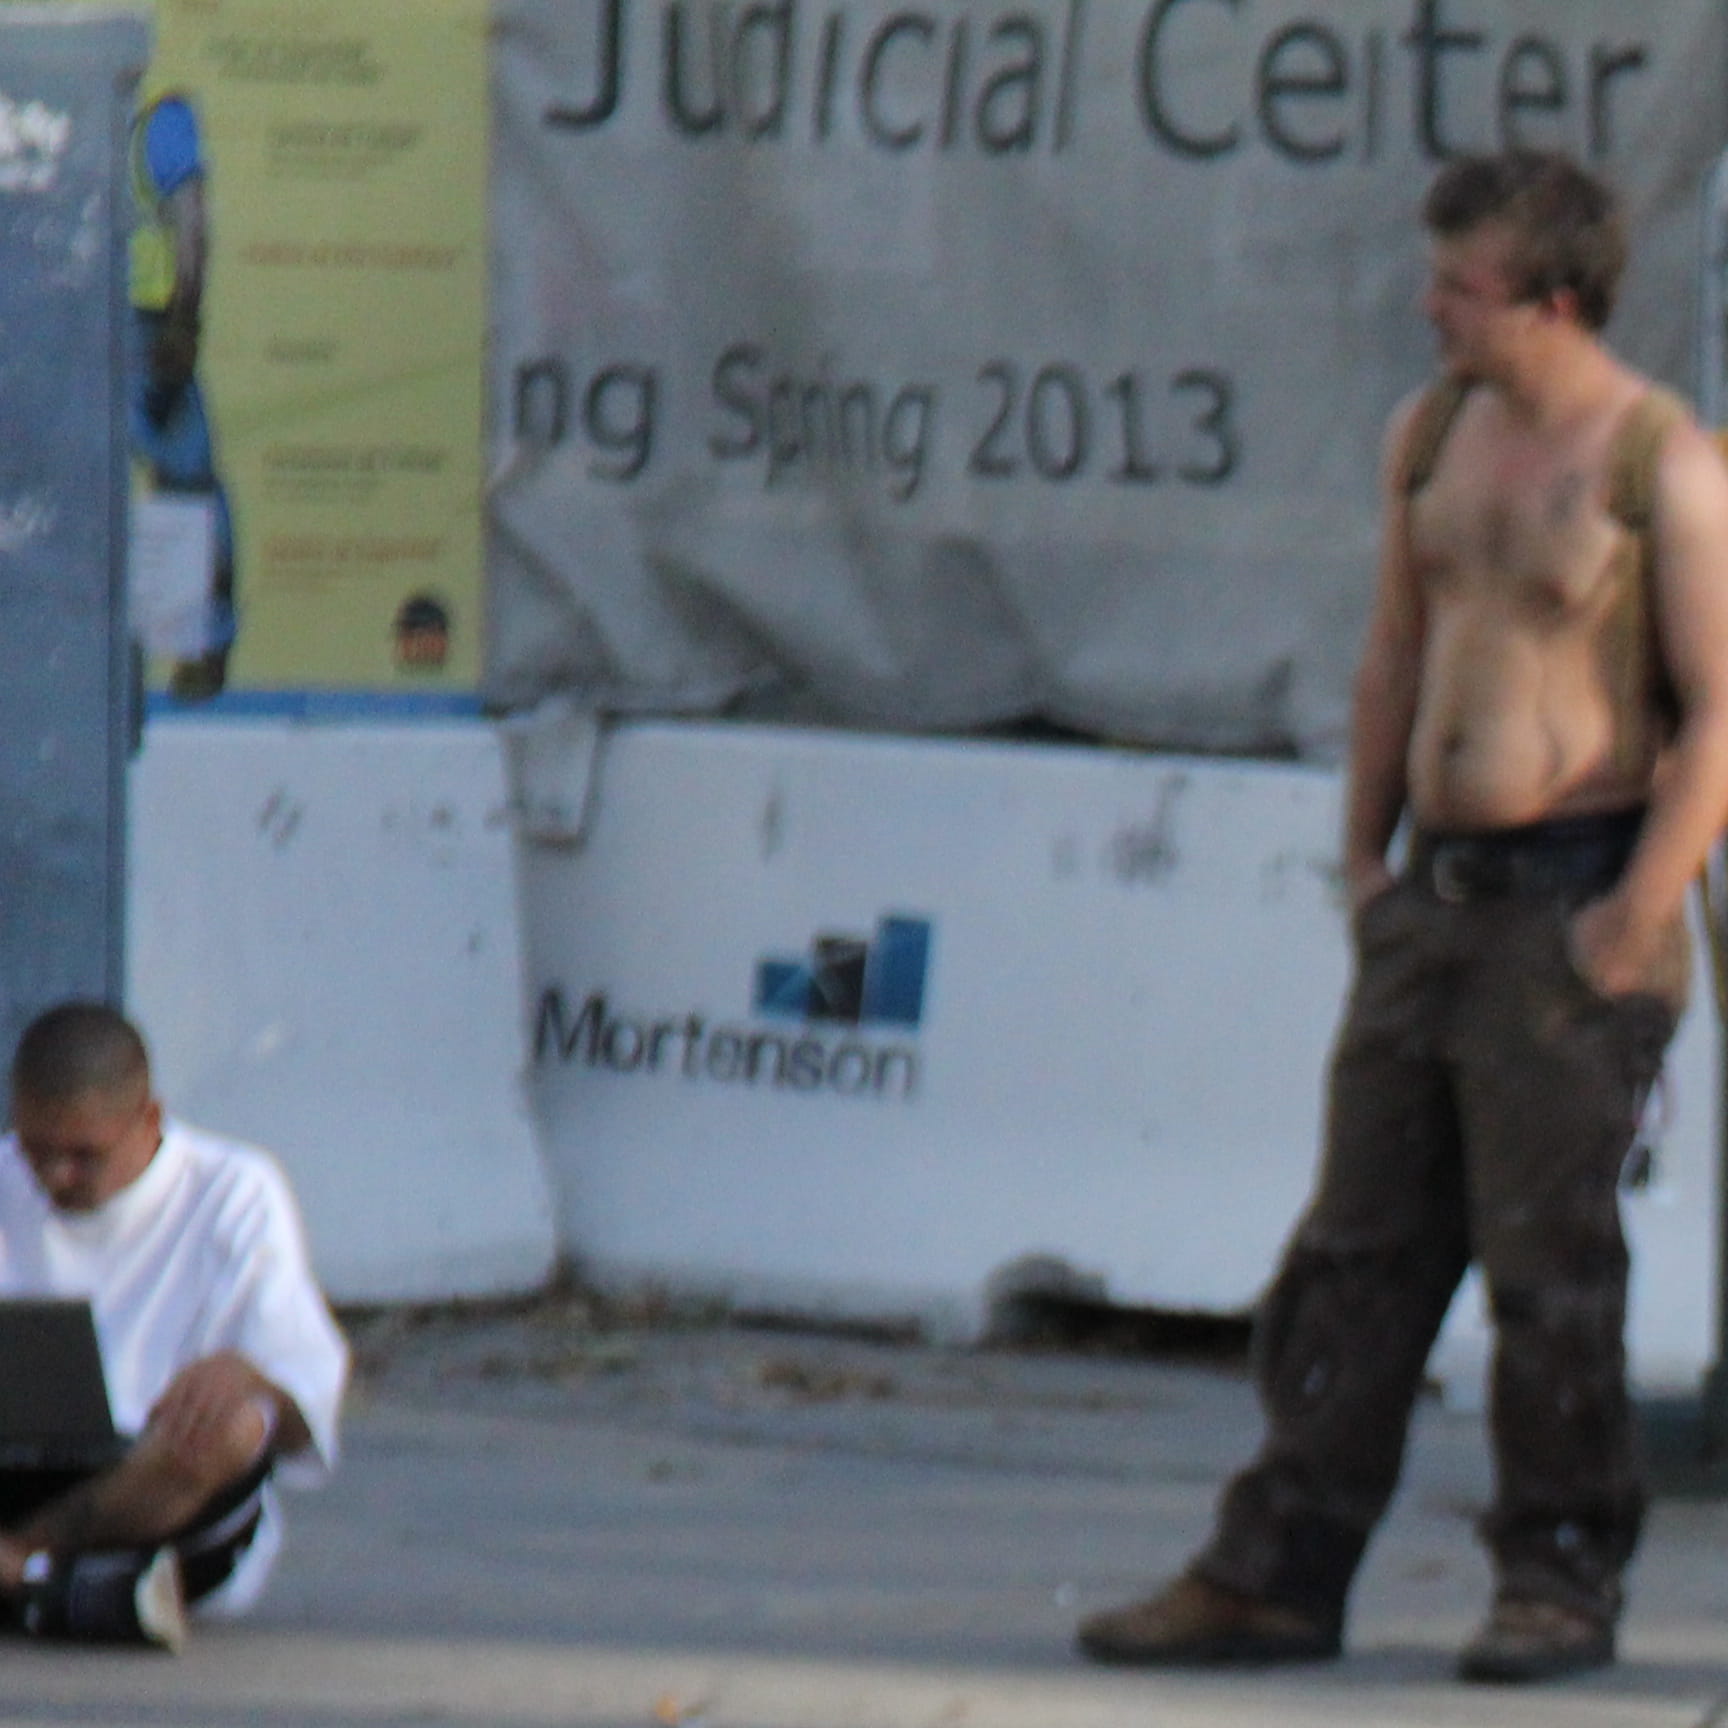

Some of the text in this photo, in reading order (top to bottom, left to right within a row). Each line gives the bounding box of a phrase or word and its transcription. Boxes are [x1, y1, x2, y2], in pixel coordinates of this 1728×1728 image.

[543, 0, 1083, 155] Judicial
[966, 358, 1243, 488] 2013
[532, 984, 921, 1094] Mortenson
